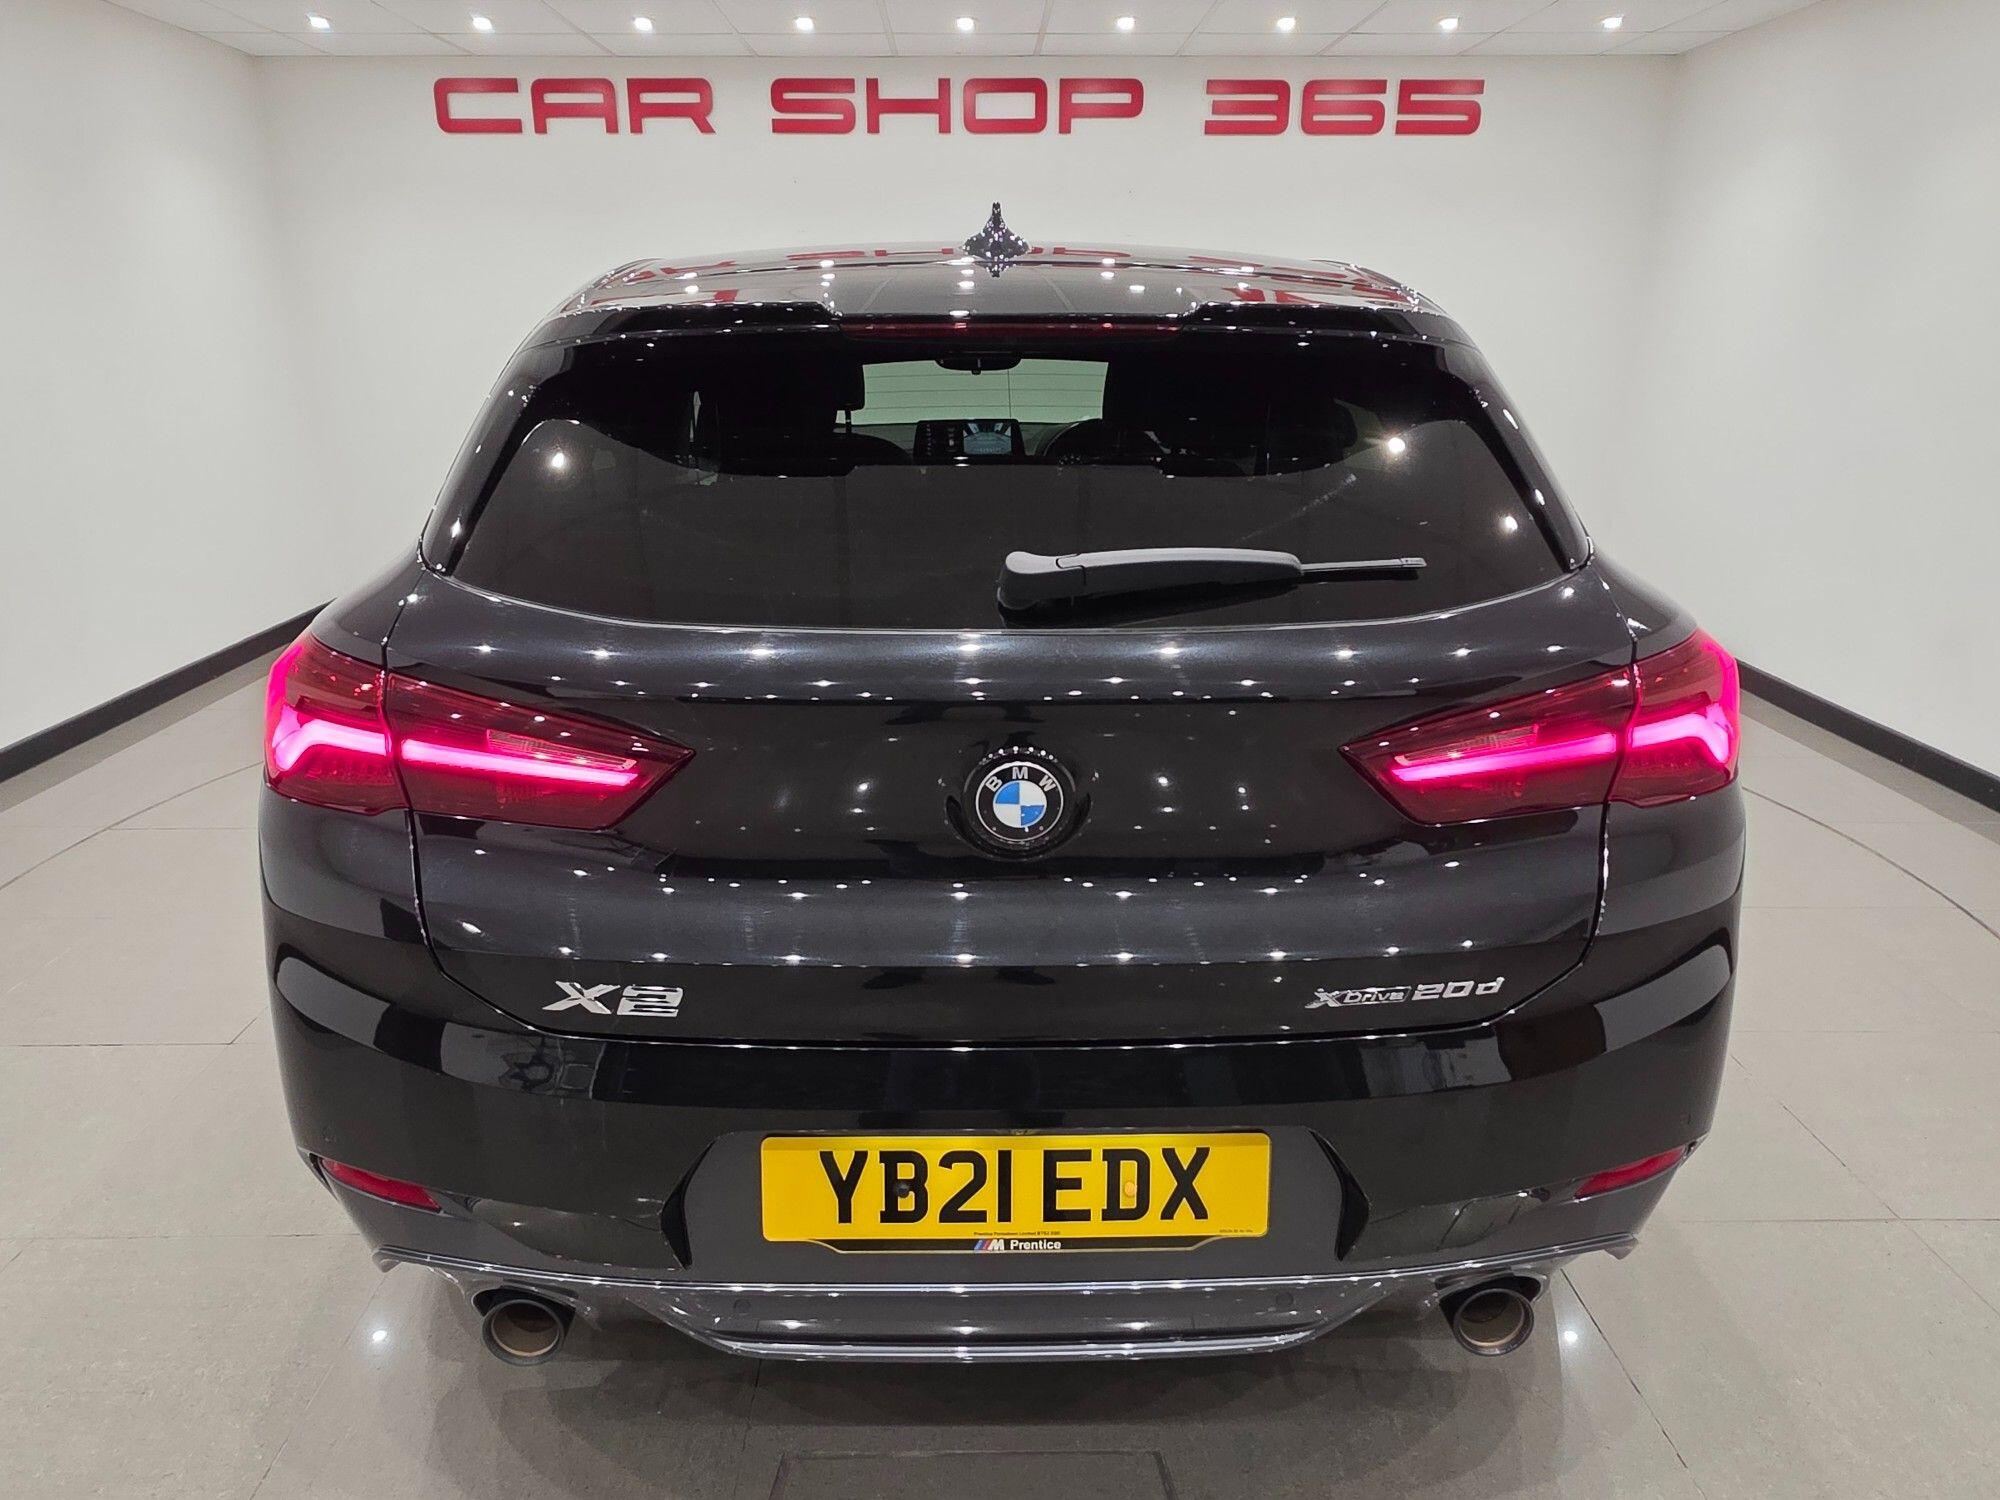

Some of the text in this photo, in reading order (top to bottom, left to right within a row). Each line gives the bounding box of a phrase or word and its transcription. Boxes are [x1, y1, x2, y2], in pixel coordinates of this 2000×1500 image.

[433, 77, 1486, 137] CAR SHOP 365
[985, 766, 1056, 792] BMW
[541, 980, 684, 1018] X2
[1411, 976, 1506, 1001] 20d
[818, 1146, 1211, 1224] YB21 EDX
[985, 1238, 1062, 1251] M Prentice
